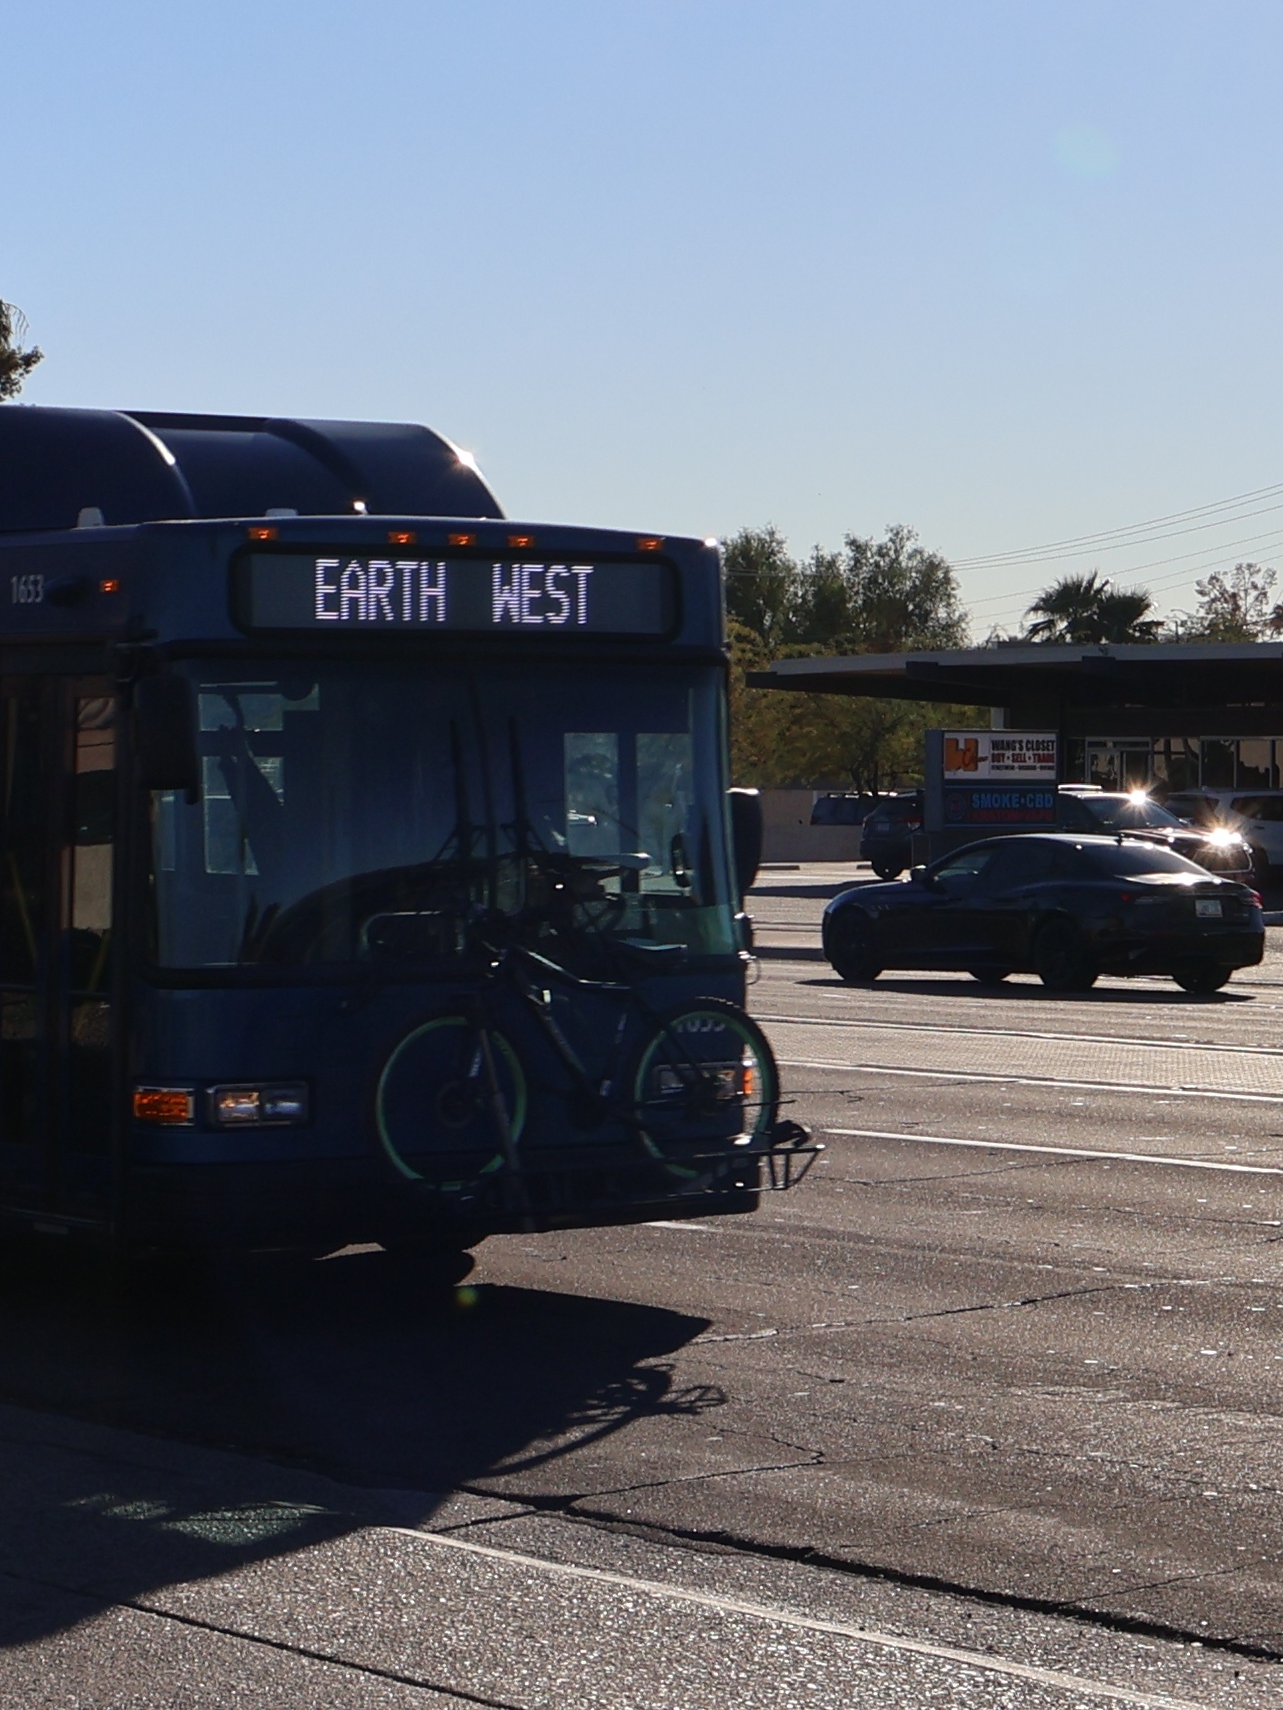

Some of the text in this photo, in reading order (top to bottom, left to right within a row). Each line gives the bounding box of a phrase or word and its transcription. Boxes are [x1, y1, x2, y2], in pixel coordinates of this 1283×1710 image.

[11, 573, 44, 603] 1653
[315, 559, 595, 624] EARTH WEST
[991, 739, 1056, 752] WANG'S CLOSET
[972, 793, 1054, 809] SMOKE CBD
